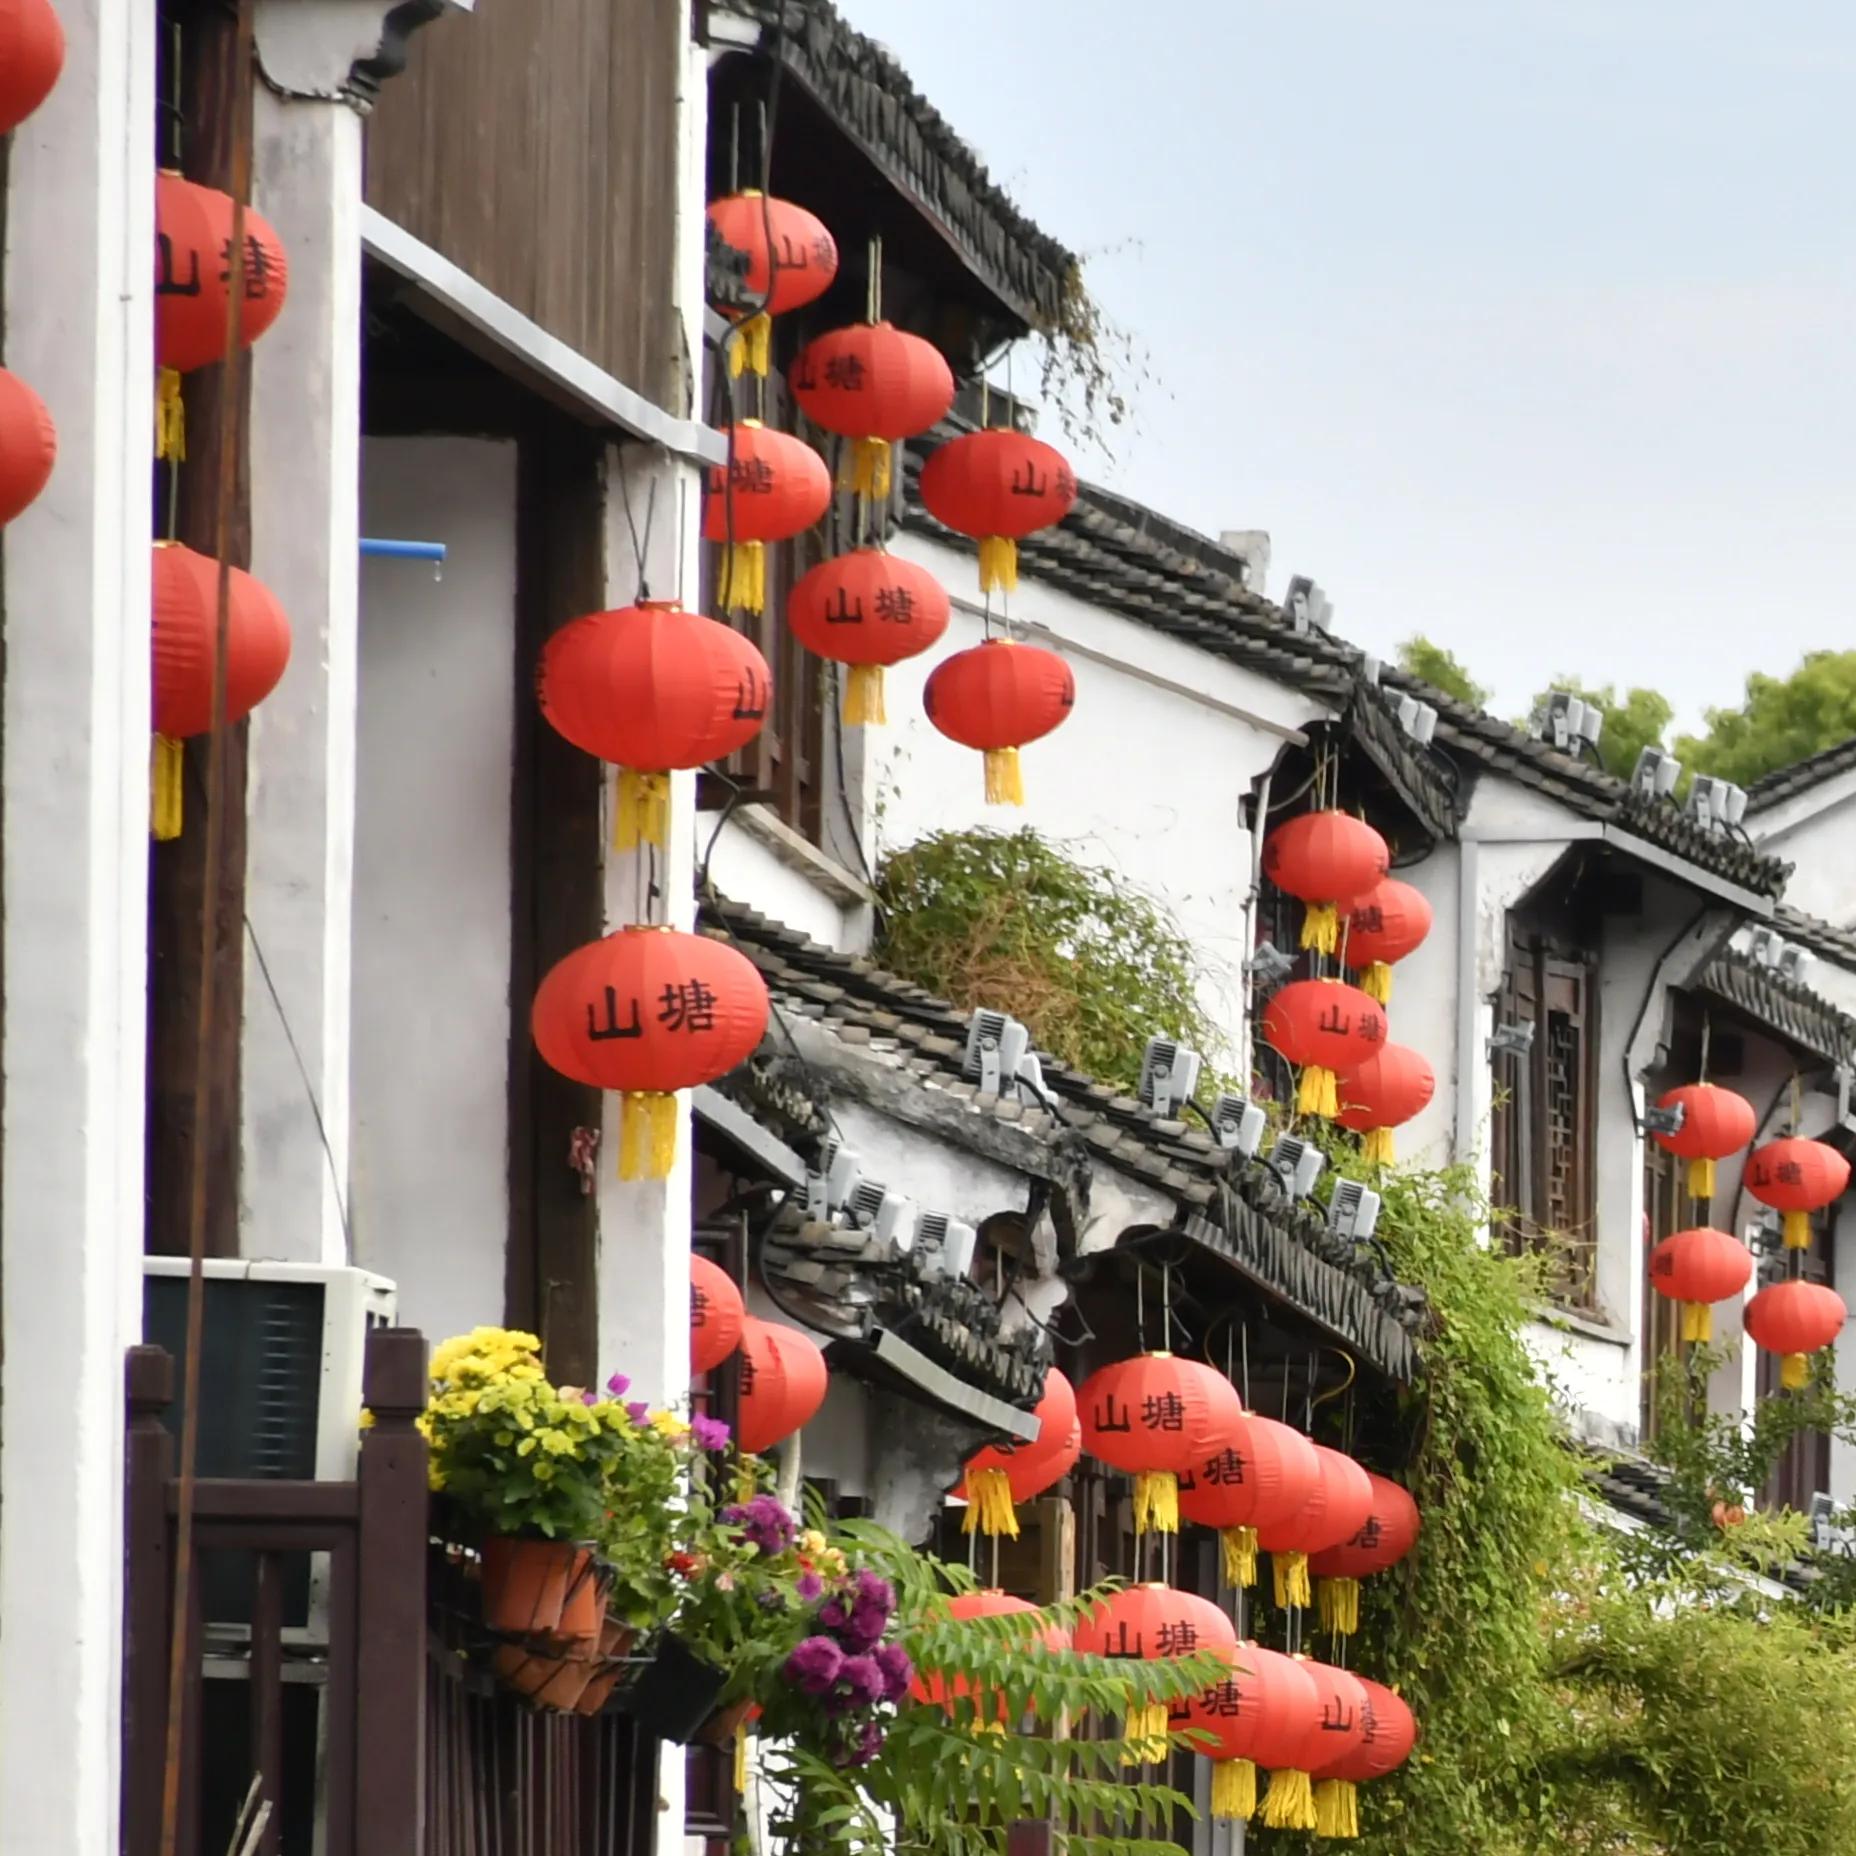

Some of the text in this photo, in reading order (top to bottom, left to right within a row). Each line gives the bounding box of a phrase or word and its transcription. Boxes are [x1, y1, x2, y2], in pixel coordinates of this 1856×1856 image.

[826, 585, 915, 625] 山塘
[588, 978, 719, 1042] 山塘
[1094, 1391, 1187, 1433] 山塘
[1103, 1619, 1201, 1661] 山塘
